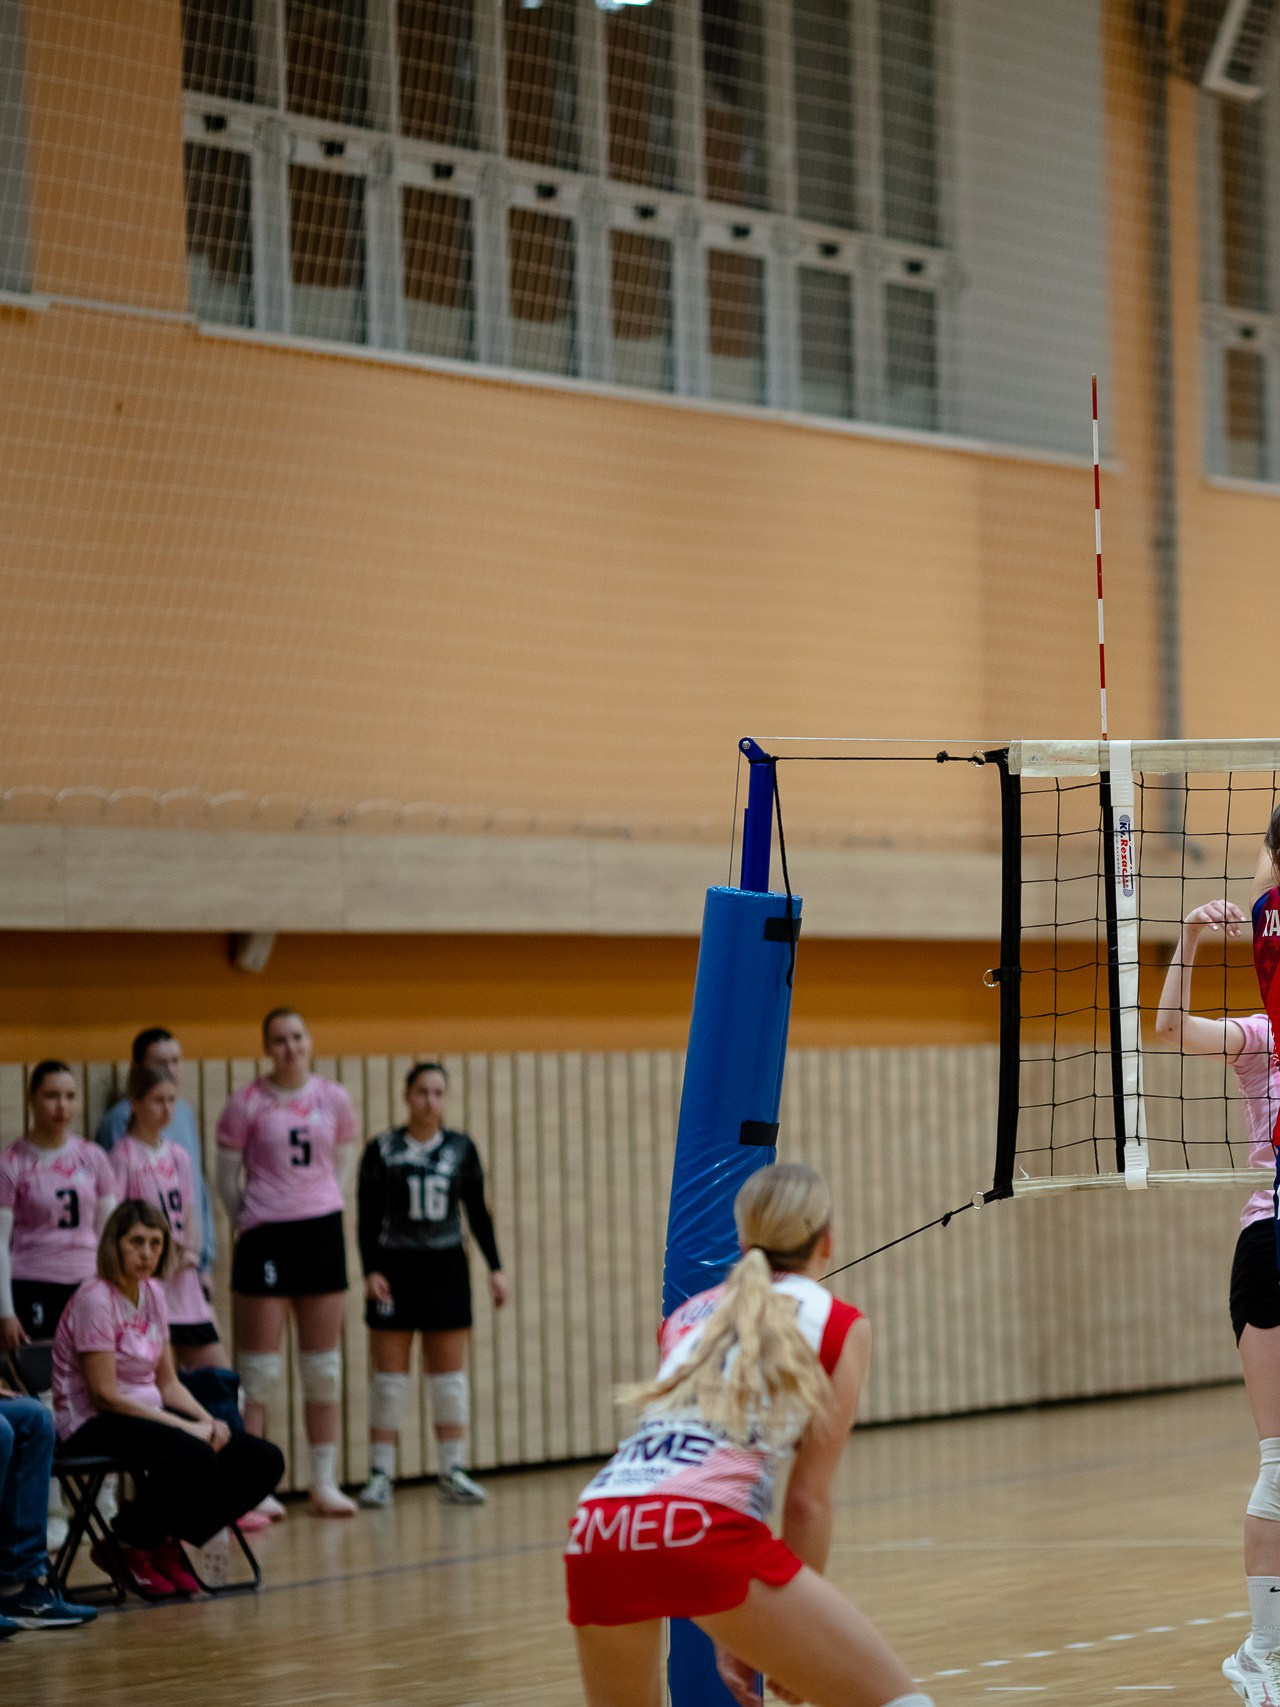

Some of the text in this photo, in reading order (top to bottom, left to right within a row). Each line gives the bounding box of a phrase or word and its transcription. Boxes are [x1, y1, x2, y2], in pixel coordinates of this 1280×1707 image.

[288, 1128, 311, 1167] 5
[56, 1189, 79, 1228] 3
[407, 1174, 450, 1222] 16
[32, 1301, 44, 1327] 3
